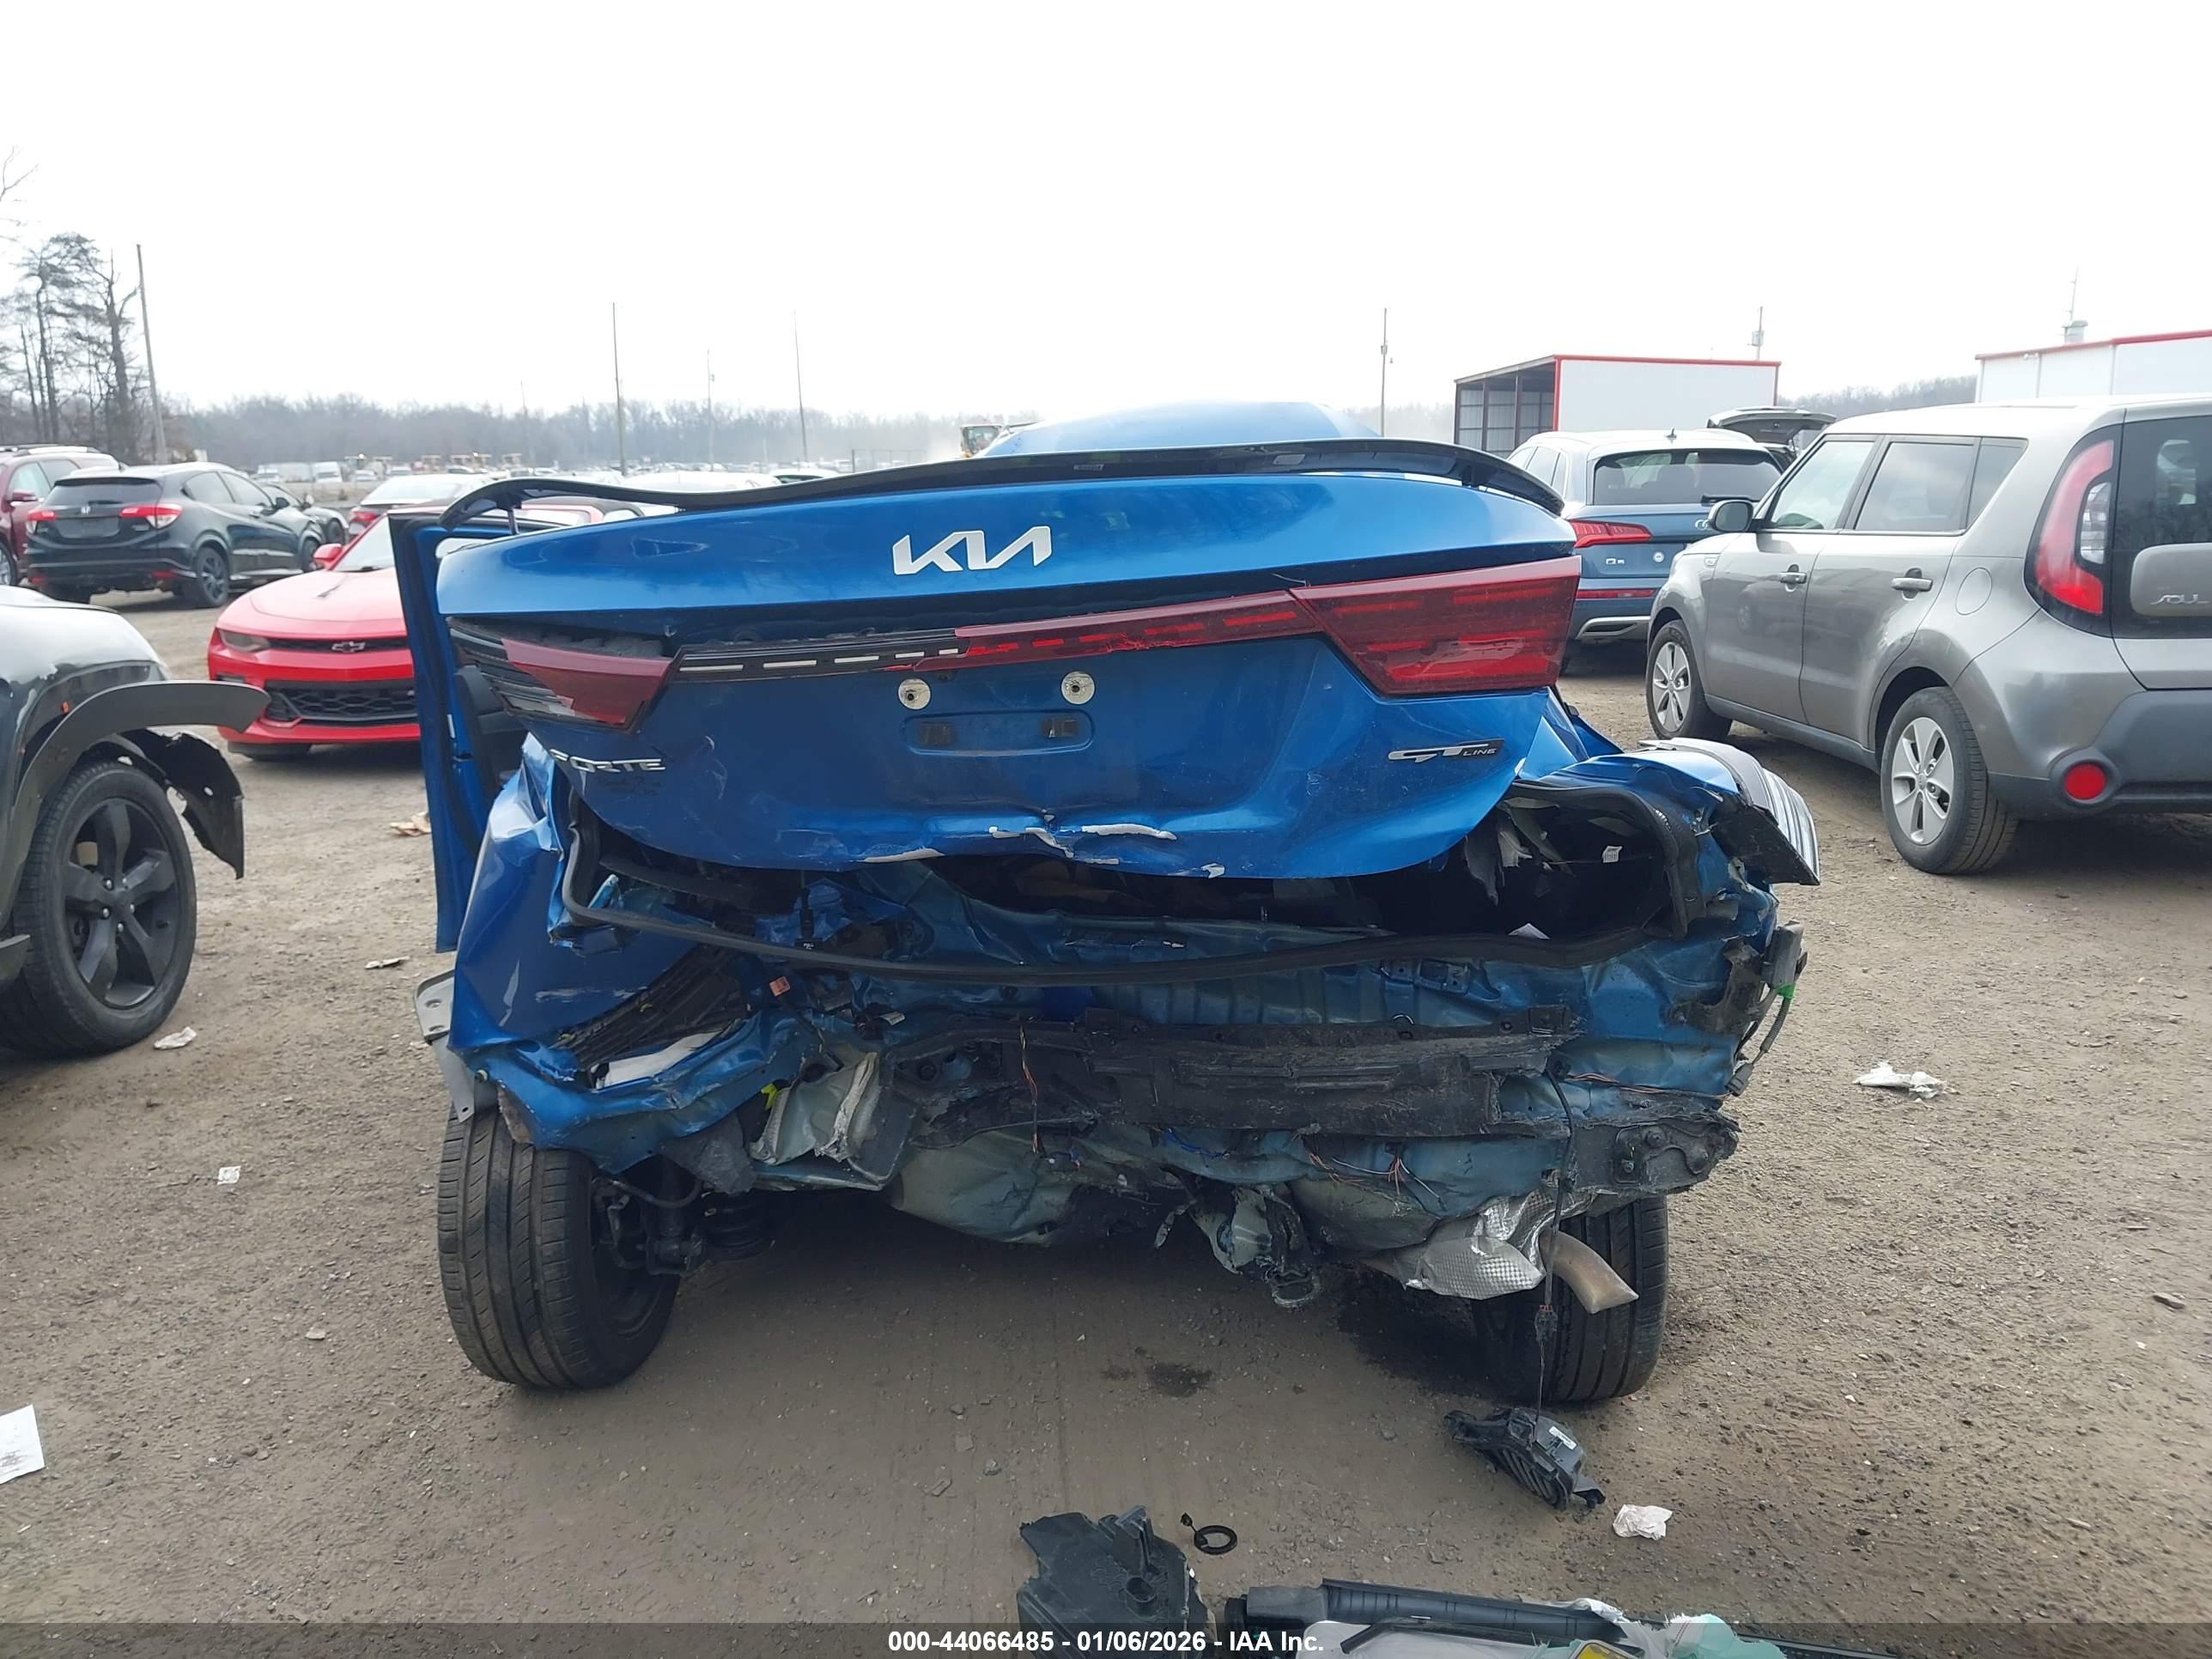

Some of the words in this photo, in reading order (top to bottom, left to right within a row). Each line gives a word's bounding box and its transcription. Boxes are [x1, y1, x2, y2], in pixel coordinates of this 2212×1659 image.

[892, 526, 1052, 575] KIA
[550, 748, 666, 773] FORTE
[1388, 743, 1489, 763] GT
[1462, 748, 1498, 757] LINE
